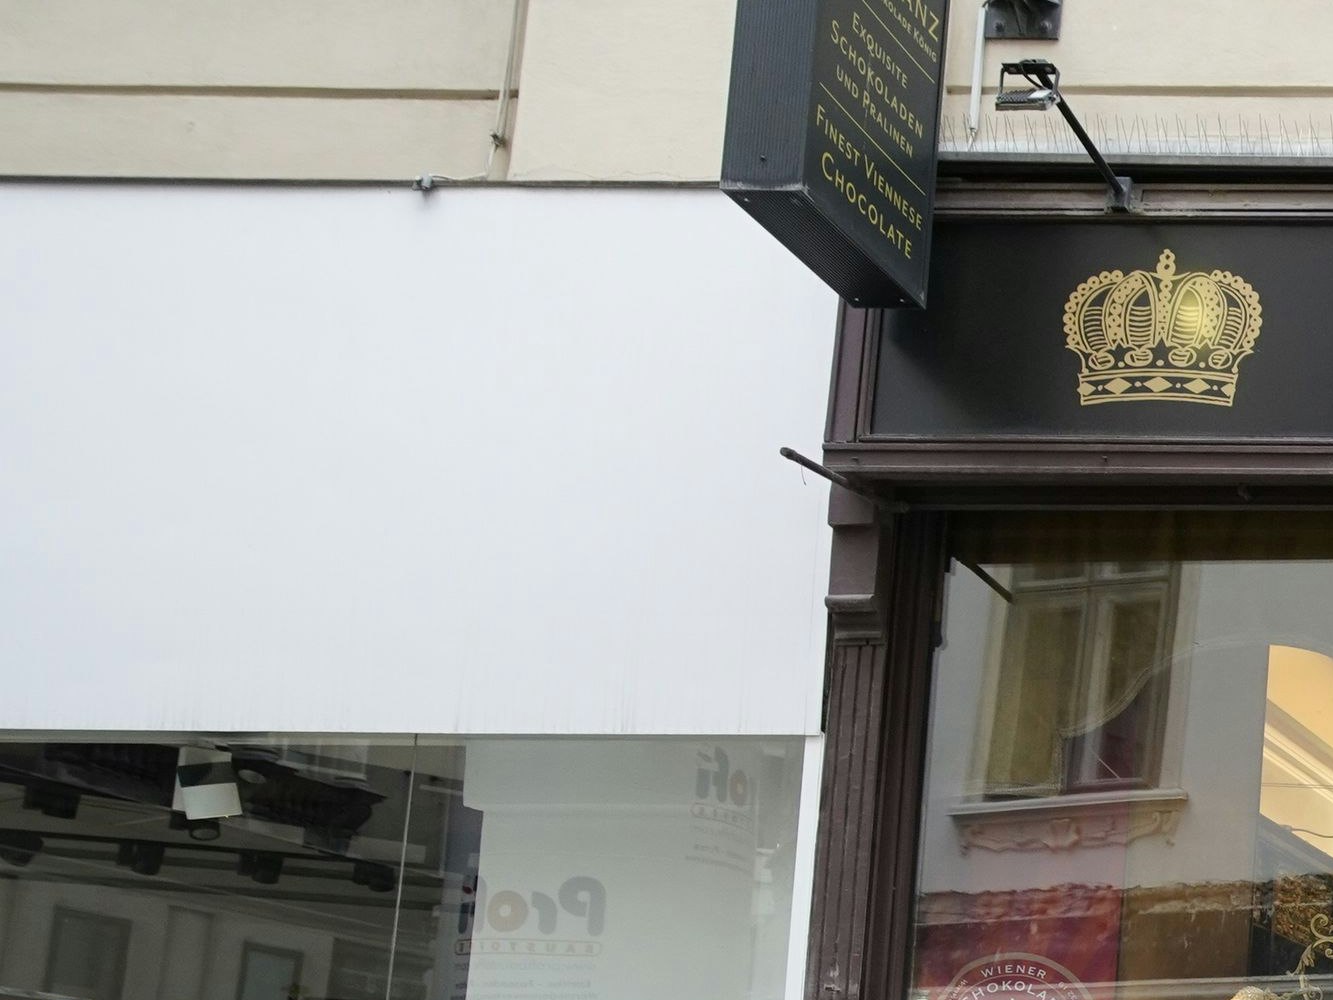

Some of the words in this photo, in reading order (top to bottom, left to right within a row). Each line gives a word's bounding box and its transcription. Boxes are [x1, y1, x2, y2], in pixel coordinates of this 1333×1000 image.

[831, 20, 923, 139] SCHOKOLADEN
[852, 12, 908, 89] EXQUISITE
[836, 64, 859, 99] UND
[862, 91, 913, 159] PRALINEN
[816, 104, 861, 167] FINEST
[864, 153, 922, 231] VIENNESE
[821, 151, 912, 260] CHOCOLATE
[980, 963, 1047, 980] WIENER
